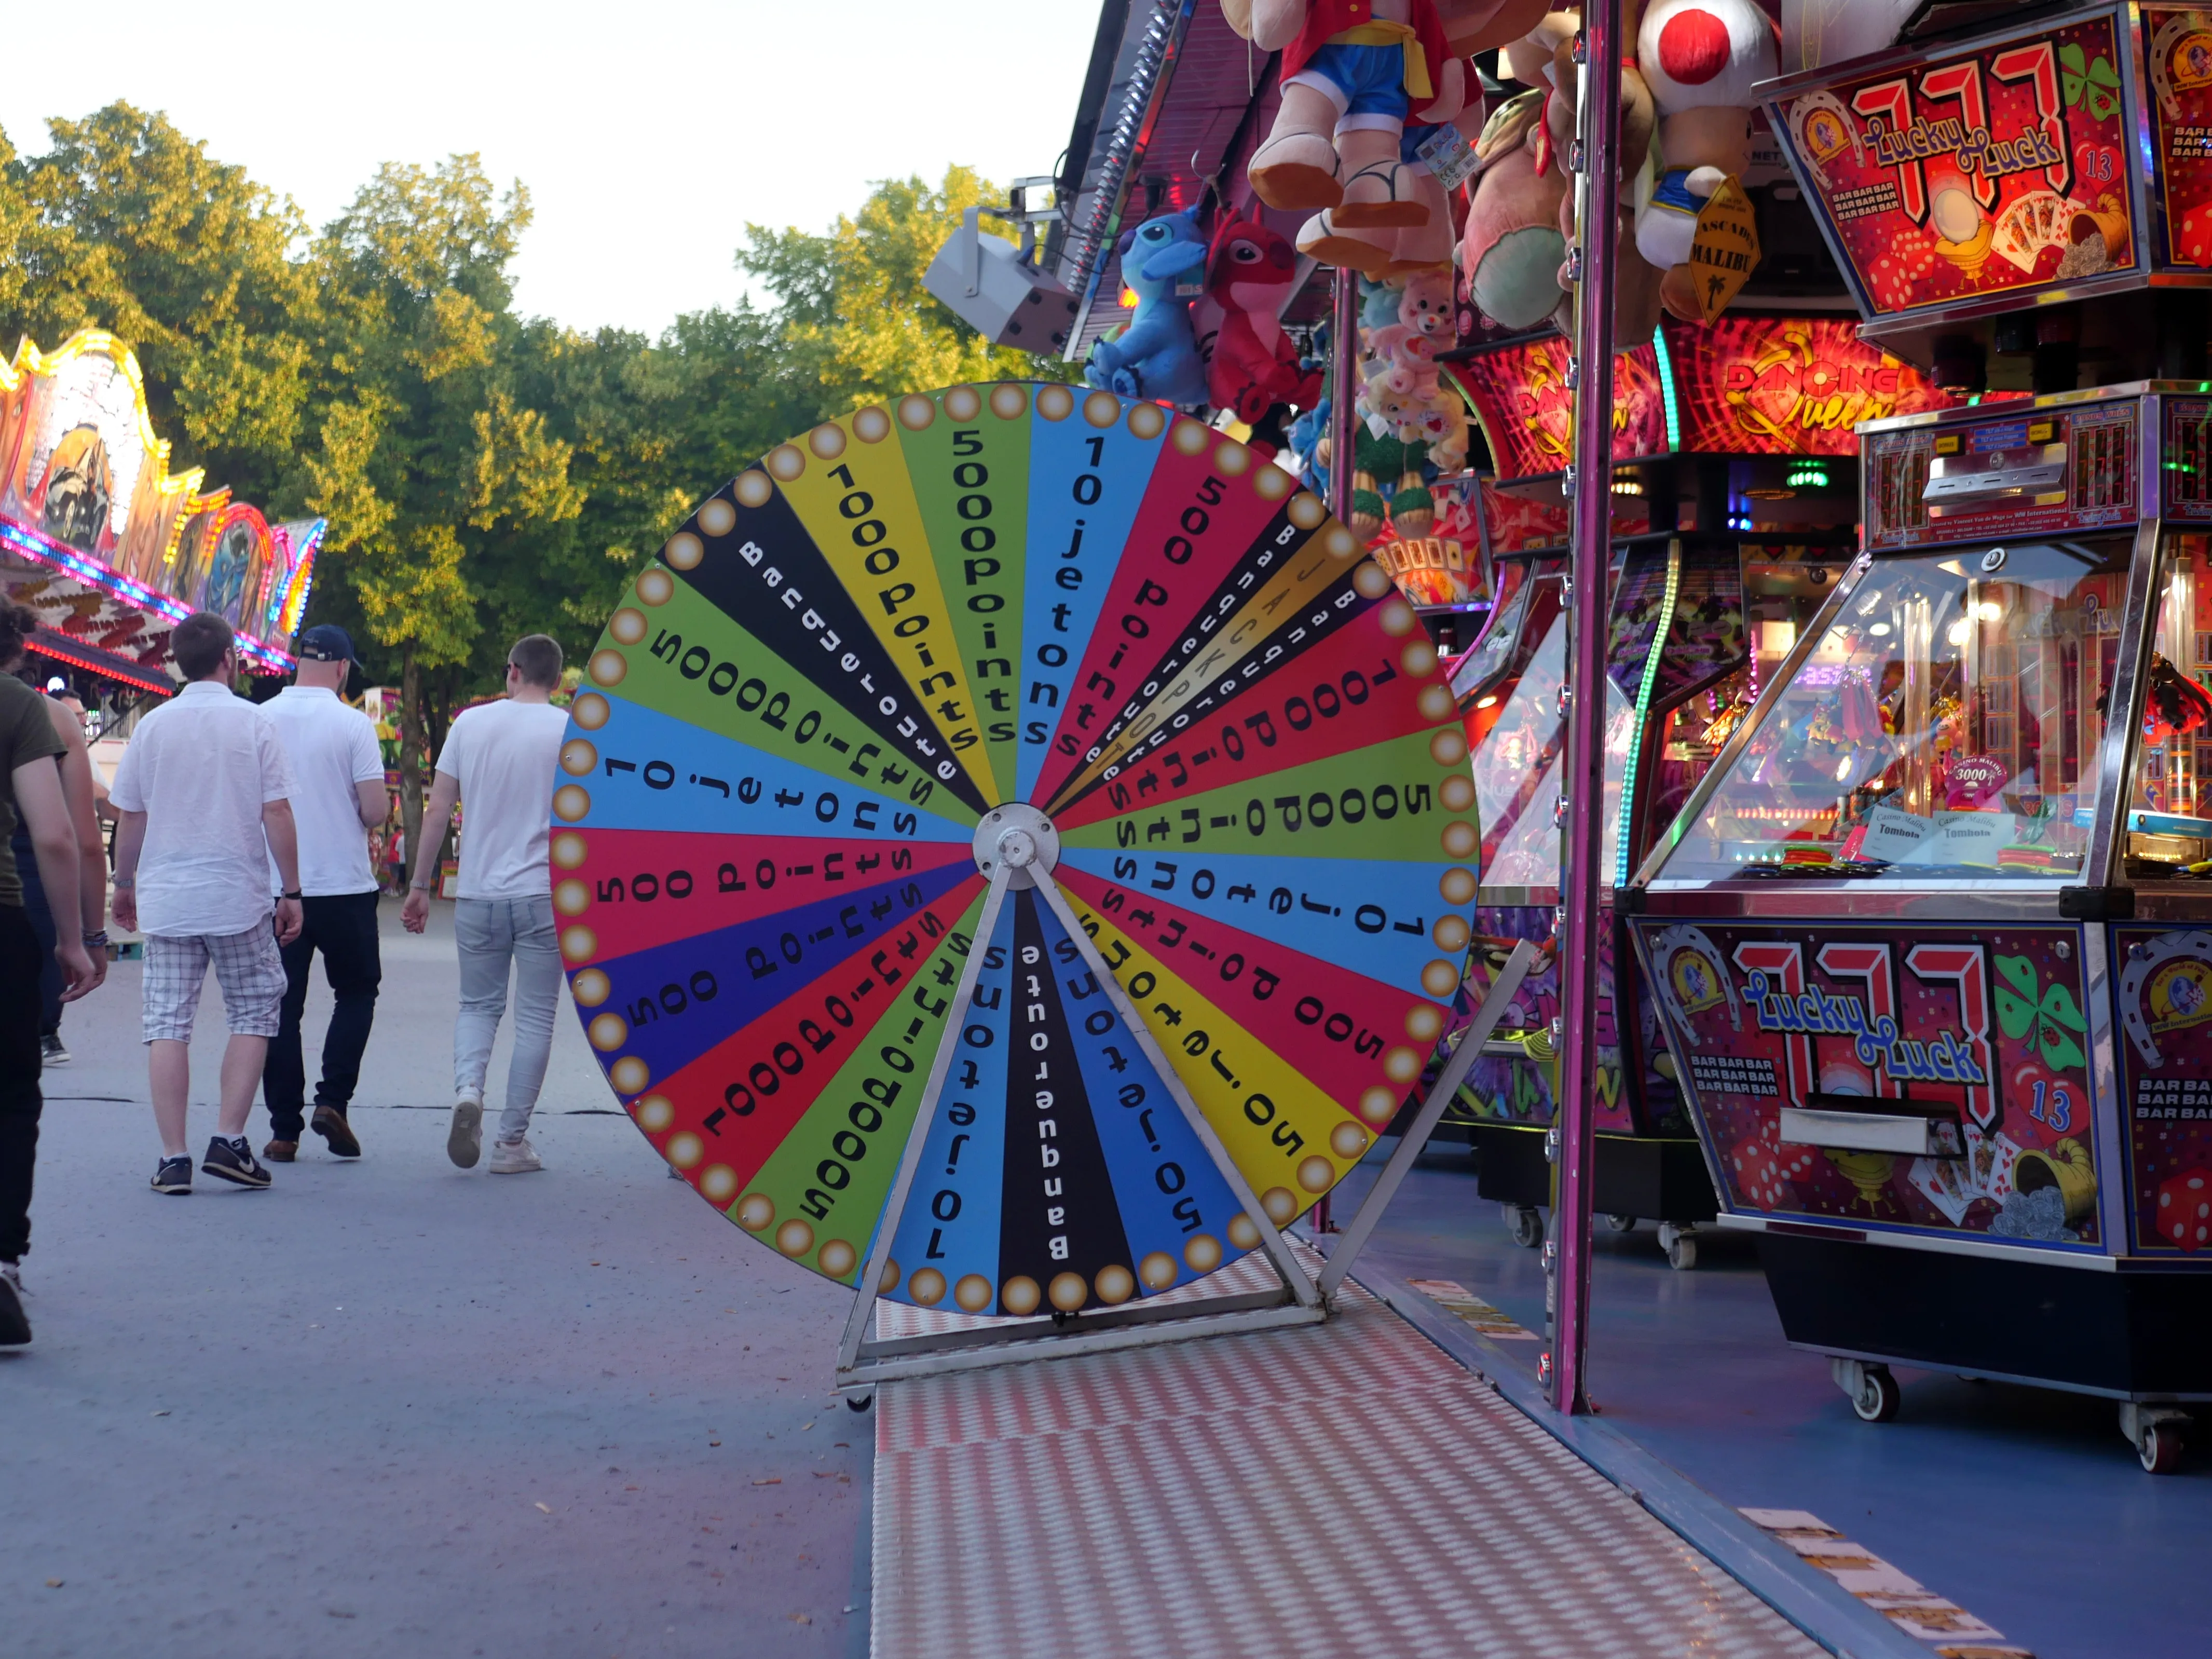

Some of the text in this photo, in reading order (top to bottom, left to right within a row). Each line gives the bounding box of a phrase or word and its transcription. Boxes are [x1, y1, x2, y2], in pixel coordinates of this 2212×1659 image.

[1861, 116, 2064, 179] Lucky Luck
[2174, 138, 2203, 146] BAR
[2175, 127, 2205, 136] BAR
[2086, 149, 2113, 182] 13
[2172, 148, 2202, 156] BAR
[1832, 182, 1894, 202] BAR BAR BAR
[1835, 191, 1897, 212] BAR BAR BAR
[1837, 201, 1900, 221] BAR BAR BAR
[1725, 360, 1900, 397] DANCING
[2027, 507, 2067, 517] International
[1024, 436, 1103, 745] 10 jetons
[1056, 476, 1227, 756] 500 points
[738, 540, 957, 780] Banqueroute
[1086, 524, 1296, 763] Banqueroute
[1096, 559, 1326, 770] JACKPOT
[1103, 590, 1356, 781] Banqueroute
[1949, 757, 2002, 777] CASINO MALIBU
[1955, 768, 1987, 781] 3000
[605, 757, 917, 836] 10 jetons
[1876, 813, 1926, 833] Casino Malibu
[1879, 823, 1920, 839] Tombola
[1938, 816, 1997, 829] Casino Malibu
[1944, 827, 1991, 839] Tombola
[597, 848, 912, 903] 500 points
[1113, 856, 1426, 936] 10 jetons
[627, 882, 925, 1028] 500 points
[1102, 888, 1385, 1060] 500 points
[1079, 913, 1304, 1158] 50 jetons
[1740, 968, 1988, 1084] Lucky Luck
[1690, 1056, 1772, 1070] BAR BAR BAR
[1693, 1068, 1776, 1083] BAR BAR BAR
[1054, 939, 1203, 1233] 50 jetons
[1696, 1080, 1778, 1096] BAR BAR BAR
[2137, 1094, 2212, 1105] BAR BA
[2139, 1080, 2212, 1091] BAR BA
[925, 946, 1008, 1260] 10 jetons
[1021, 946, 1070, 1260] Banqueroute
[2028, 1079, 2071, 1133] 13
[2136, 1108, 2212, 1119] BAR BA
